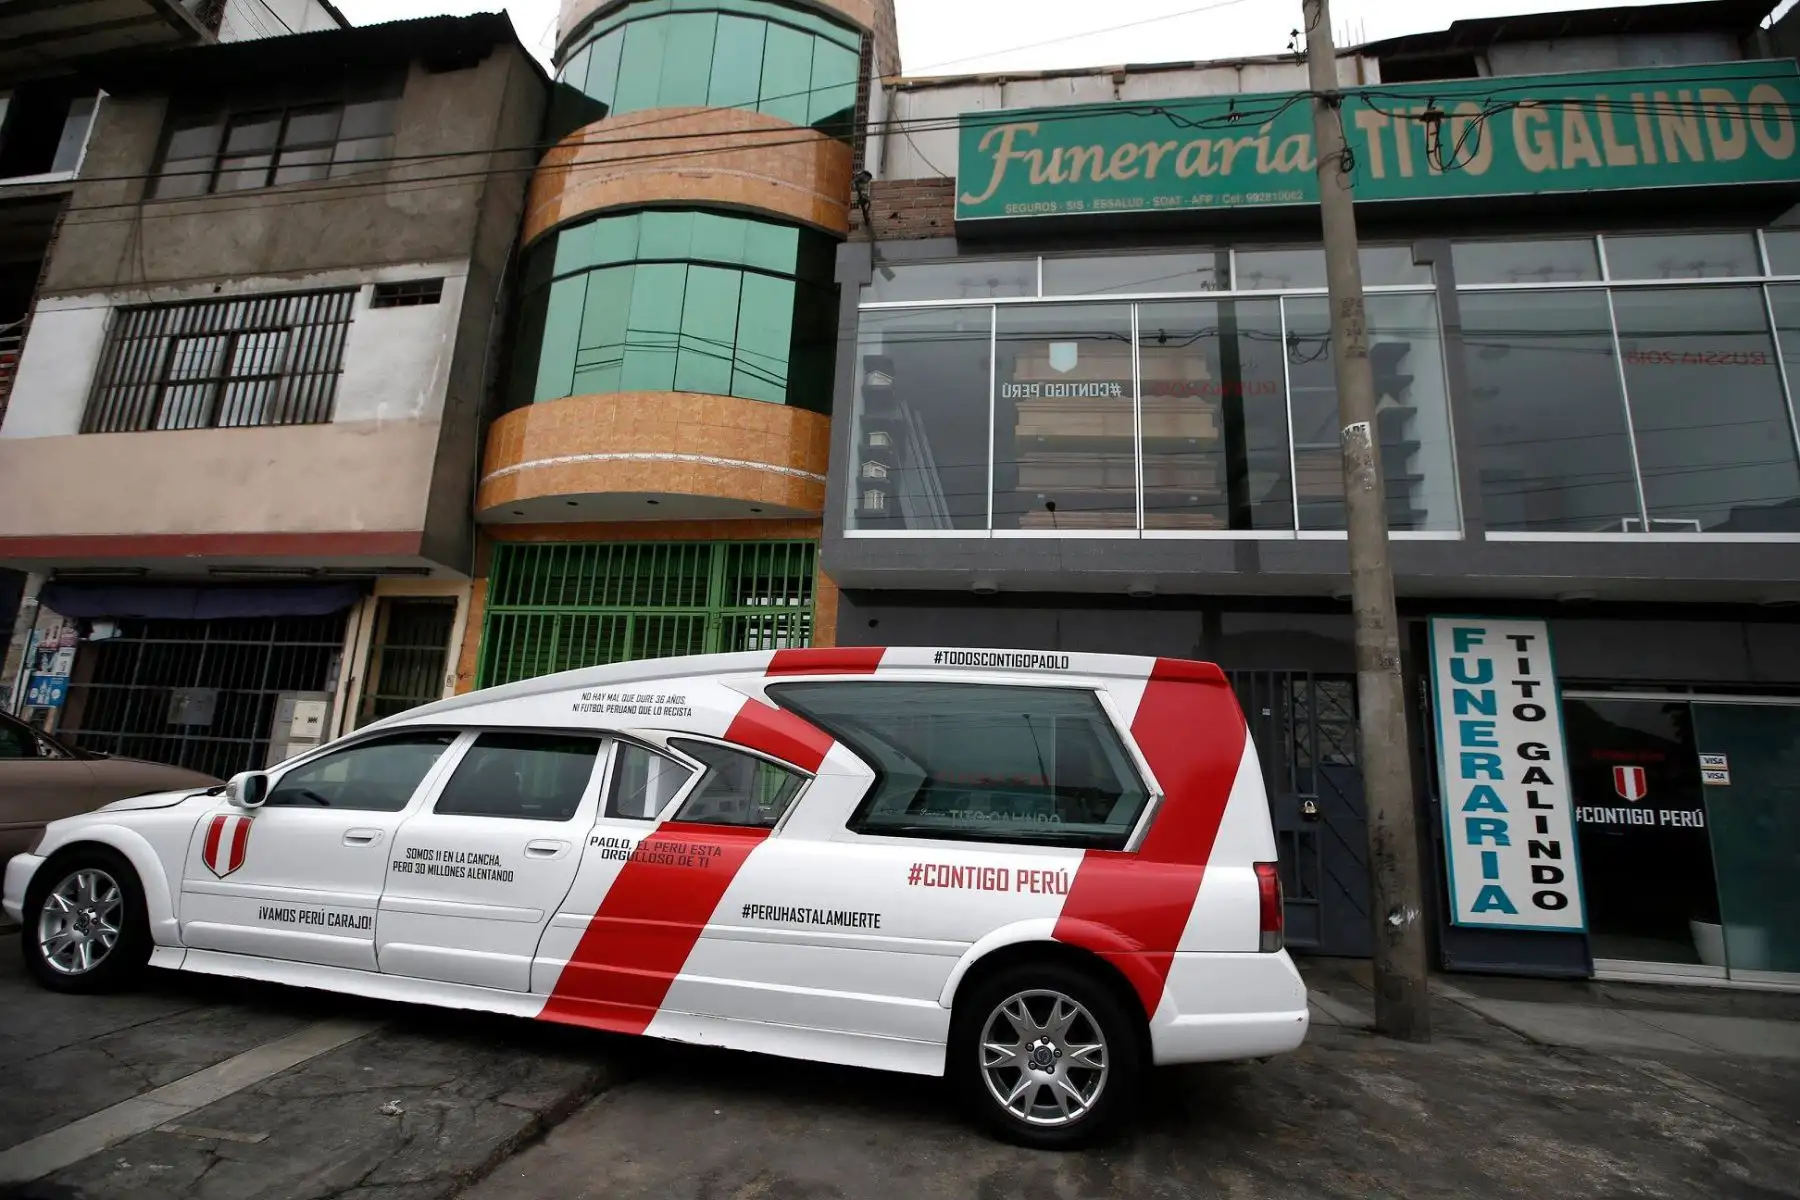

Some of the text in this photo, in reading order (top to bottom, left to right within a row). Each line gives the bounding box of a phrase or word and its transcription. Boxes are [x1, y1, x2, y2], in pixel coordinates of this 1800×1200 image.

[1355, 100, 1493, 179] TITO
[1512, 83, 1797, 174] GALINDO
[1005, 201, 1058, 214] SEGUROS
[1066, 200, 1085, 210] SIS
[1093, 197, 1144, 209] ESSALUD
[934, 650, 1069, 670] #TODOSCONTIGOPAOLO
[581, 692, 591, 701] NO
[592, 692, 606, 702] HAY
[606, 693, 620, 702] MAL
[621, 693, 635, 703] QUE
[636, 694, 654, 704] DURE
[655, 695, 665, 704] 36
[572, 703, 692, 717] NI FUTBOL PERUANO QUE LO RECISTA
[1449, 627, 1519, 915] FUNERARIA
[1703, 757, 1724, 765] VISA
[1506, 634, 1569, 911] TITO GALINDO
[1706, 771, 1725, 780] VISA
[1659, 808, 1705, 828] PERÚ
[590, 836, 632, 850] PAOLO,
[637, 841, 650, 852] EL
[690, 844, 722, 857] ESTA
[406, 847, 434, 861] SOMOS
[443, 850, 454, 862] EN
[455, 851, 465, 864] LA
[467, 852, 502, 867] CANCHA,
[601, 848, 710, 868] ORGULLOSO DE TI
[393, 860, 514, 882] PERO 30 MILLONES ALENTANDO
[907, 862, 1069, 896] #CONTIGO PERÚ
[259, 906, 372, 930] ¡VAMOS PERÚ CARAJO!
[741, 903, 882, 929] #PERUHASTALAMUERTE
